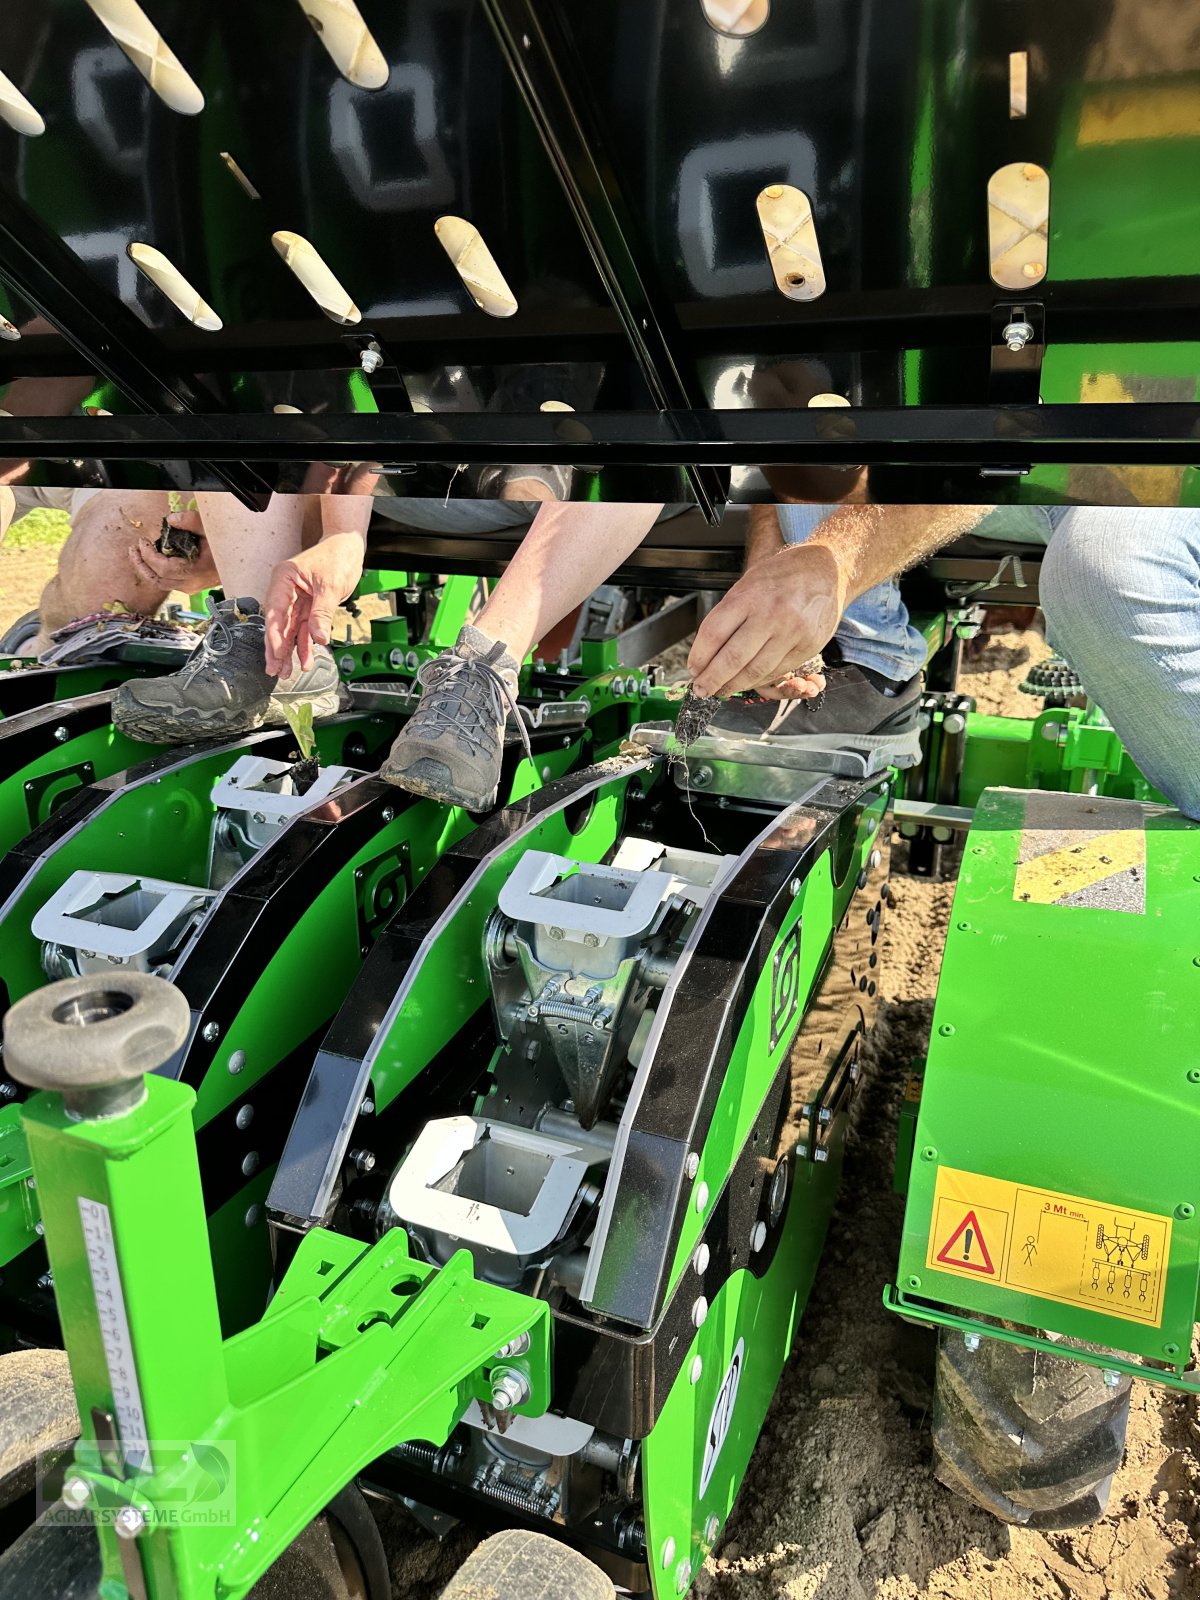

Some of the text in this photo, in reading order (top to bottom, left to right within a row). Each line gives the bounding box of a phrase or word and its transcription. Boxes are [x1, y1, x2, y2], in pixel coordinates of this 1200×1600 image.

[1044, 1202, 1087, 1219] 3 Mt min.
